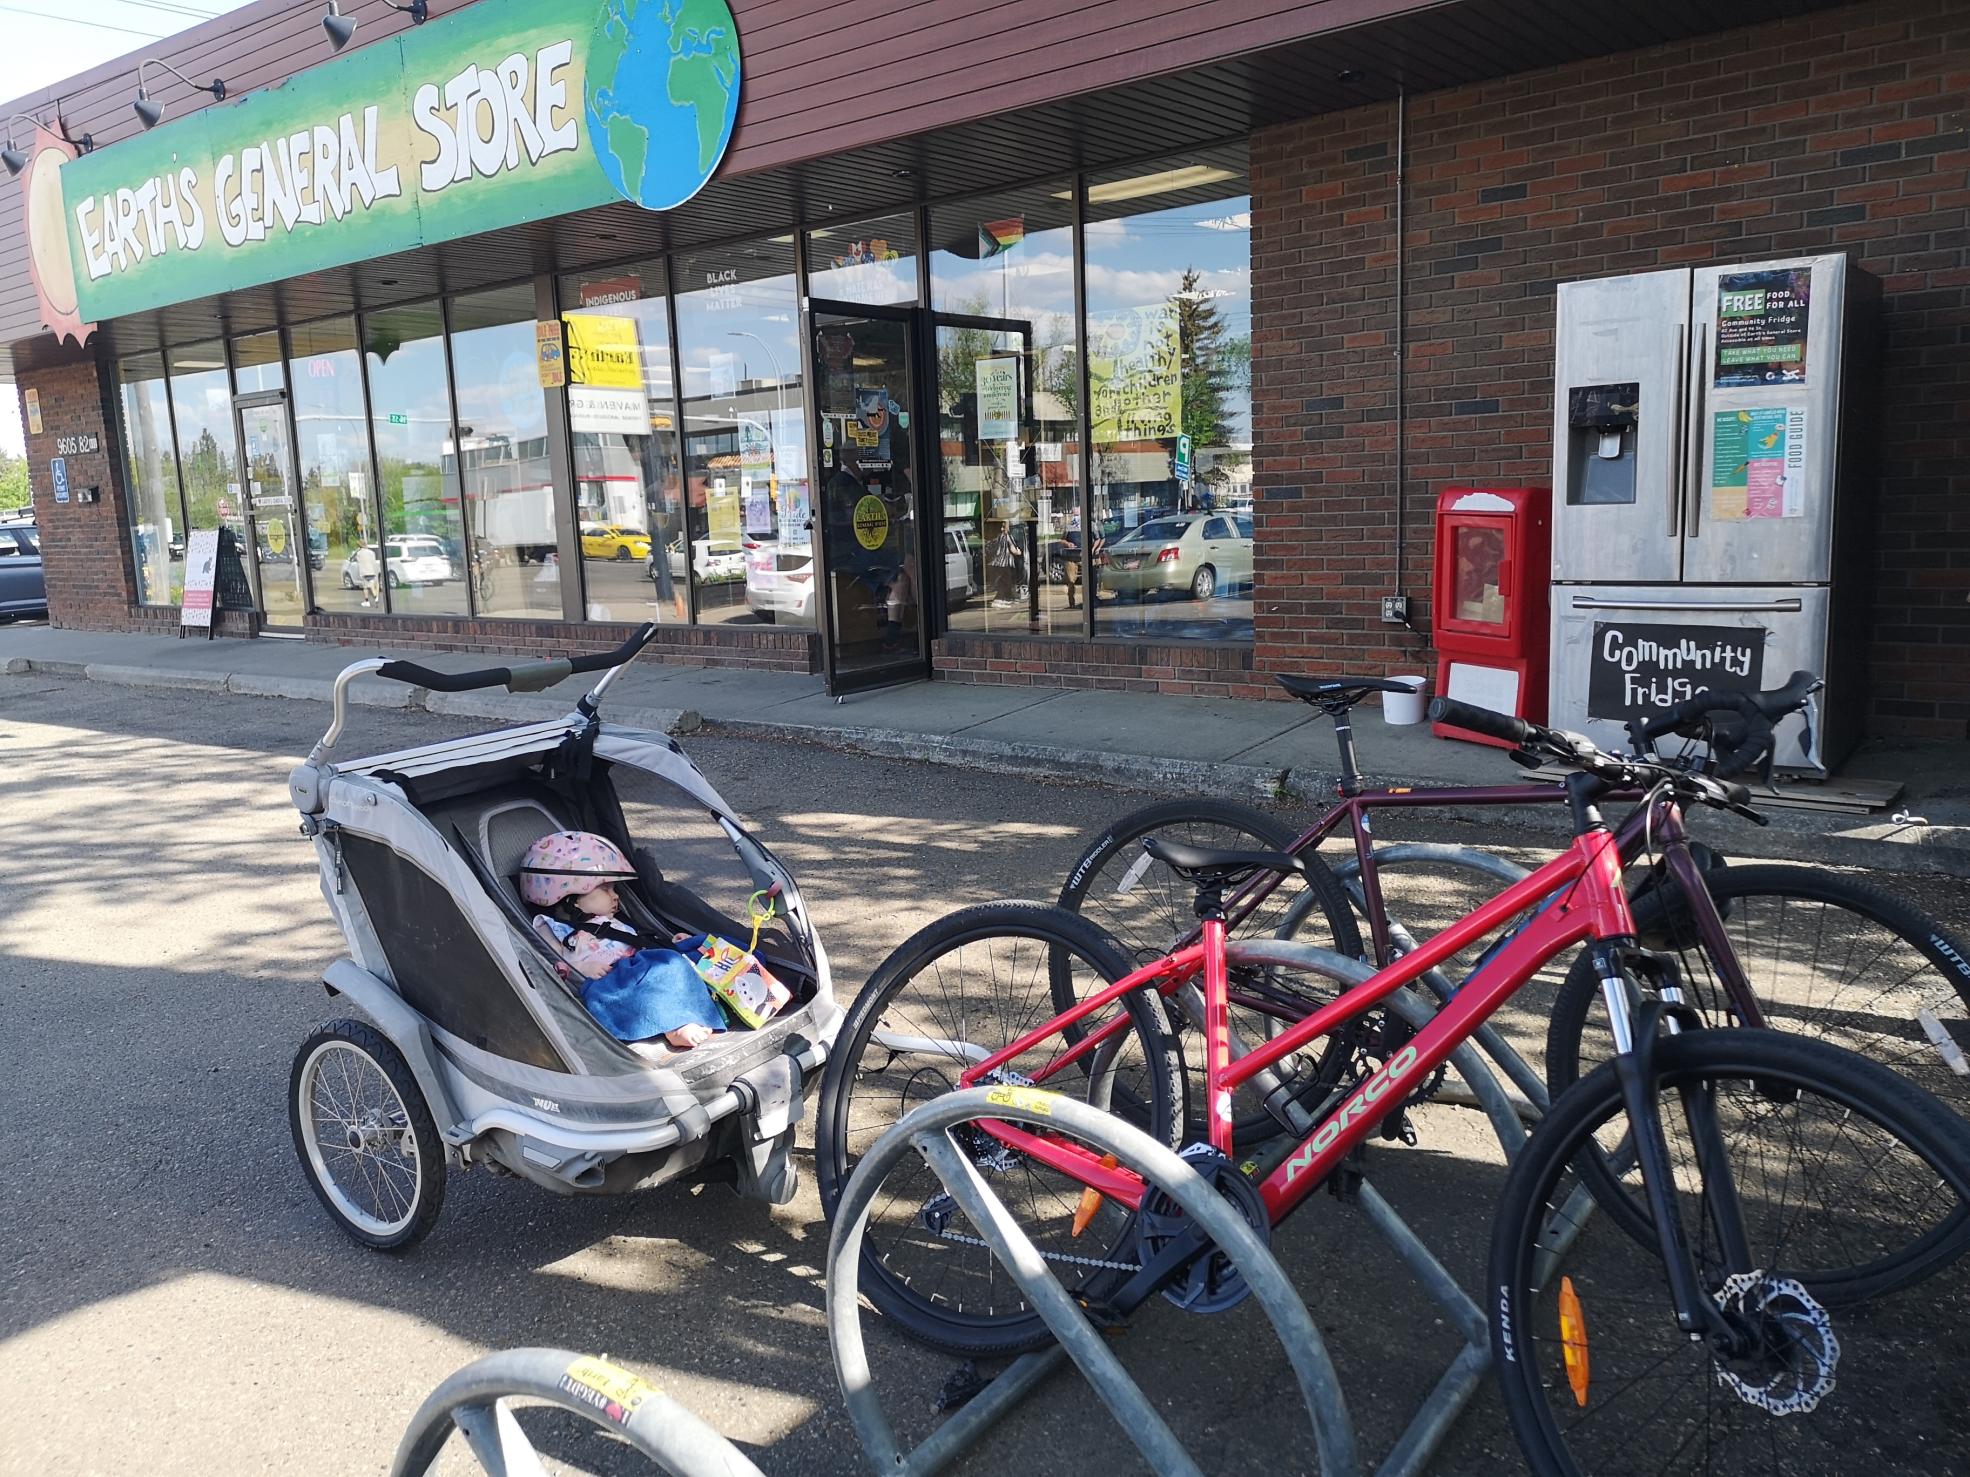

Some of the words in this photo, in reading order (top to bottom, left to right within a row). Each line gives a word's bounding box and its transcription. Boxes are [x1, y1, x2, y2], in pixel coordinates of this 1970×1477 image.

[75, 152, 205, 281] EARTH'S
[215, 106, 401, 247] GENERAL
[413, 39, 579, 191] STORE
[706, 269, 736, 284] BLACK
[586, 290, 636, 307] INDIGENOUS
[1722, 293, 1764, 312] FREE
[1767, 291, 1790, 300] FOOD
[1766, 301, 1784, 309] FOR
[1788, 299, 1806, 307] ALL
[1145, 303, 1178, 320] war
[1722, 318, 1766, 326] Community
[1768, 316, 1796, 324] Fridge
[1149, 320, 1165, 335] is
[1144, 331, 1173, 351] not
[308, 359, 335, 377] OPEN
[1119, 347, 1176, 371] healthy
[1122, 372, 1178, 395] children
[1119, 421, 1176, 437] things
[1789, 411, 1804, 440] GUIDE
[58, 437, 77, 454] 9605
[79, 436, 90, 452] 82
[1788, 444, 1802, 468] FOOD
[1603, 630, 1750, 676] Community
[1072, 858, 1092, 886] WTB
[1287, 1046, 1418, 1183] NORCO
[1500, 1285, 1516, 1362] KENDA
